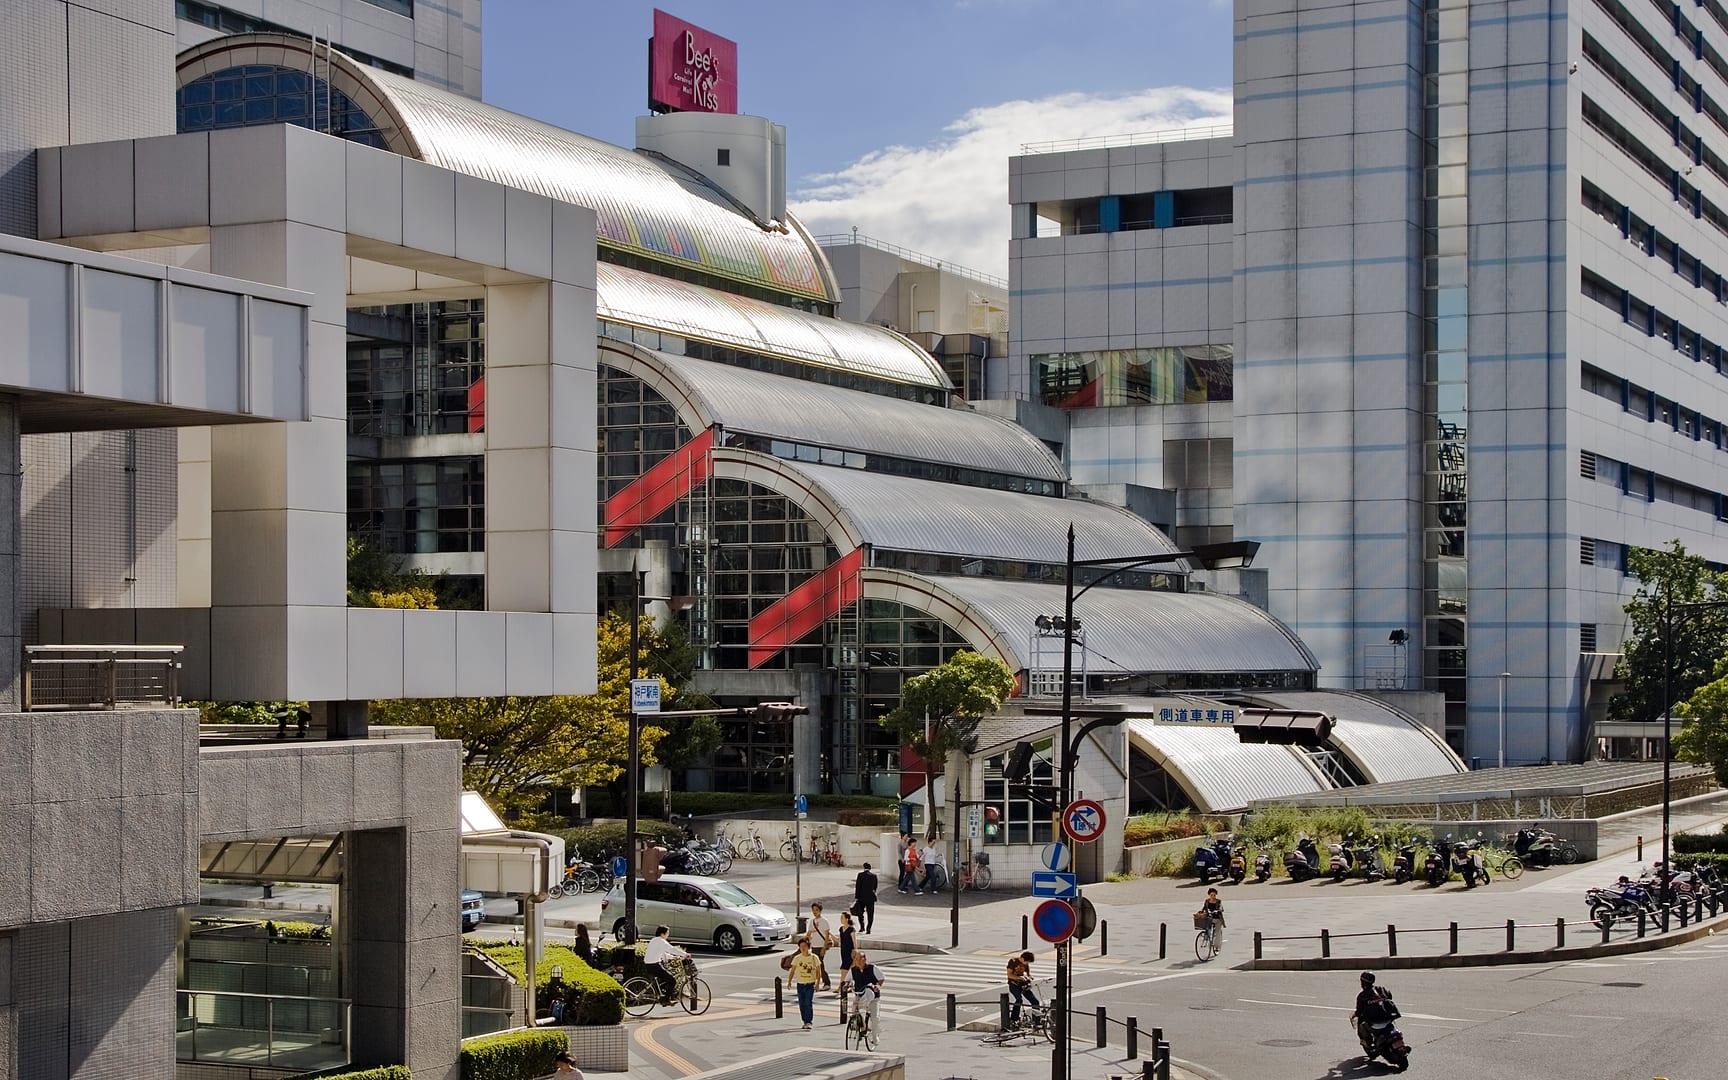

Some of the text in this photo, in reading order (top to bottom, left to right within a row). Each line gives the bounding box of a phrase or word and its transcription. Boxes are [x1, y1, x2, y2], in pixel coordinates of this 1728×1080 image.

[686, 30, 719, 82] Bee's
[693, 70, 718, 111] Kiss
[634, 685, 659, 699] 神戸駅南
[1158, 708, 1236, 723] 側道車専用
